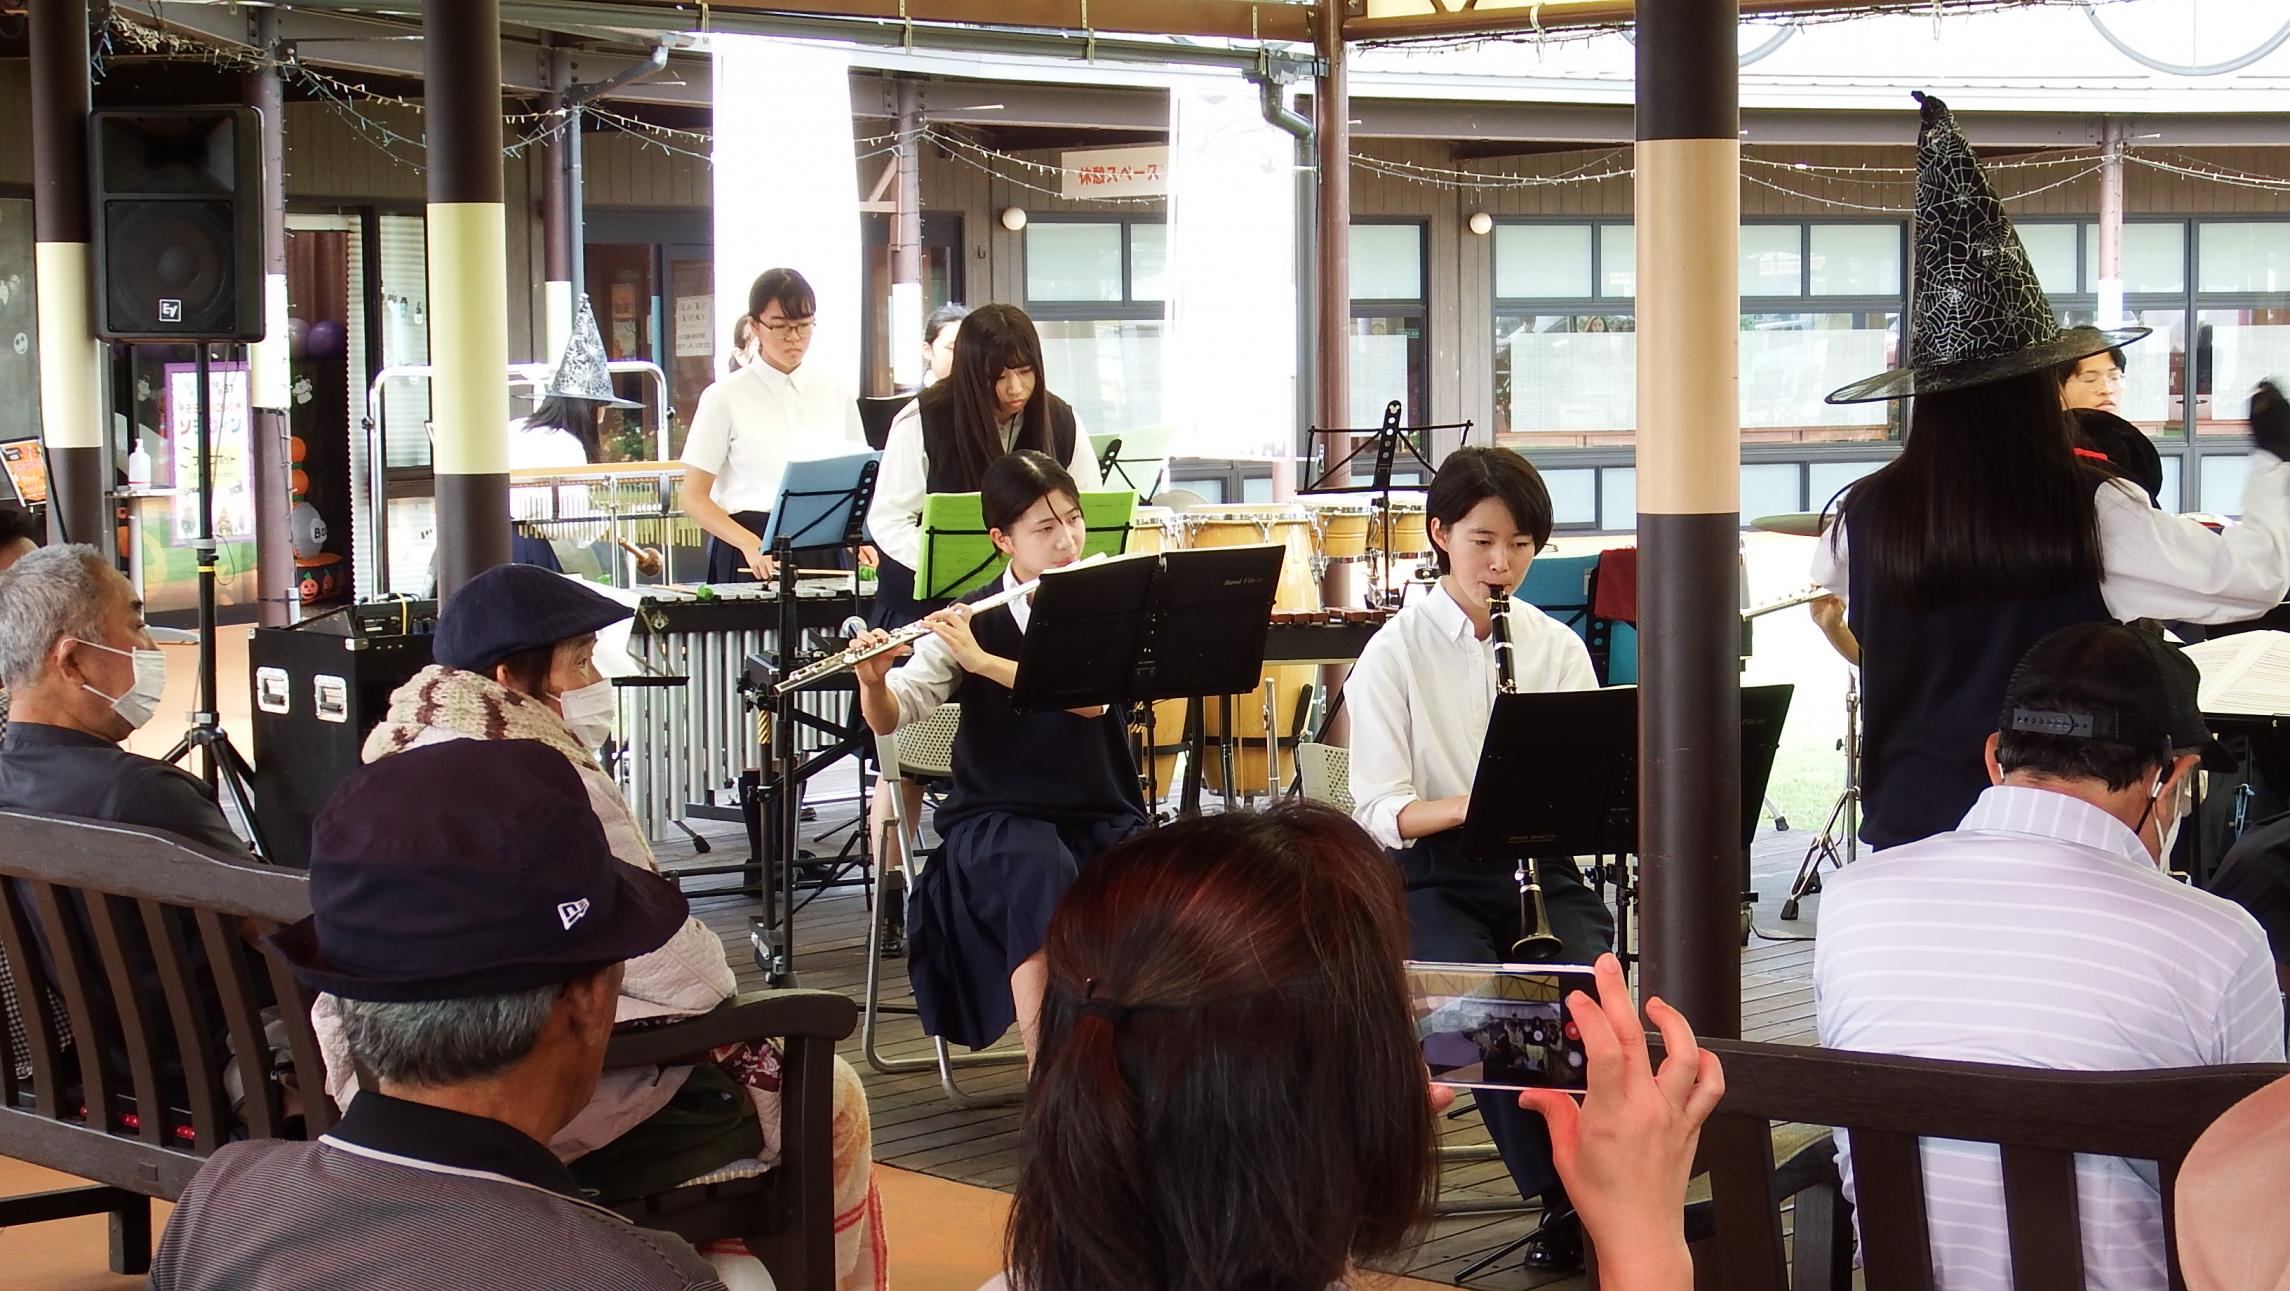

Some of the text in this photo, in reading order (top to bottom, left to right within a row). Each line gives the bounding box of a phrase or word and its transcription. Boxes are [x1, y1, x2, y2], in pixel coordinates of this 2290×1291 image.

[1079, 163, 1159, 186] 休憩スペース
